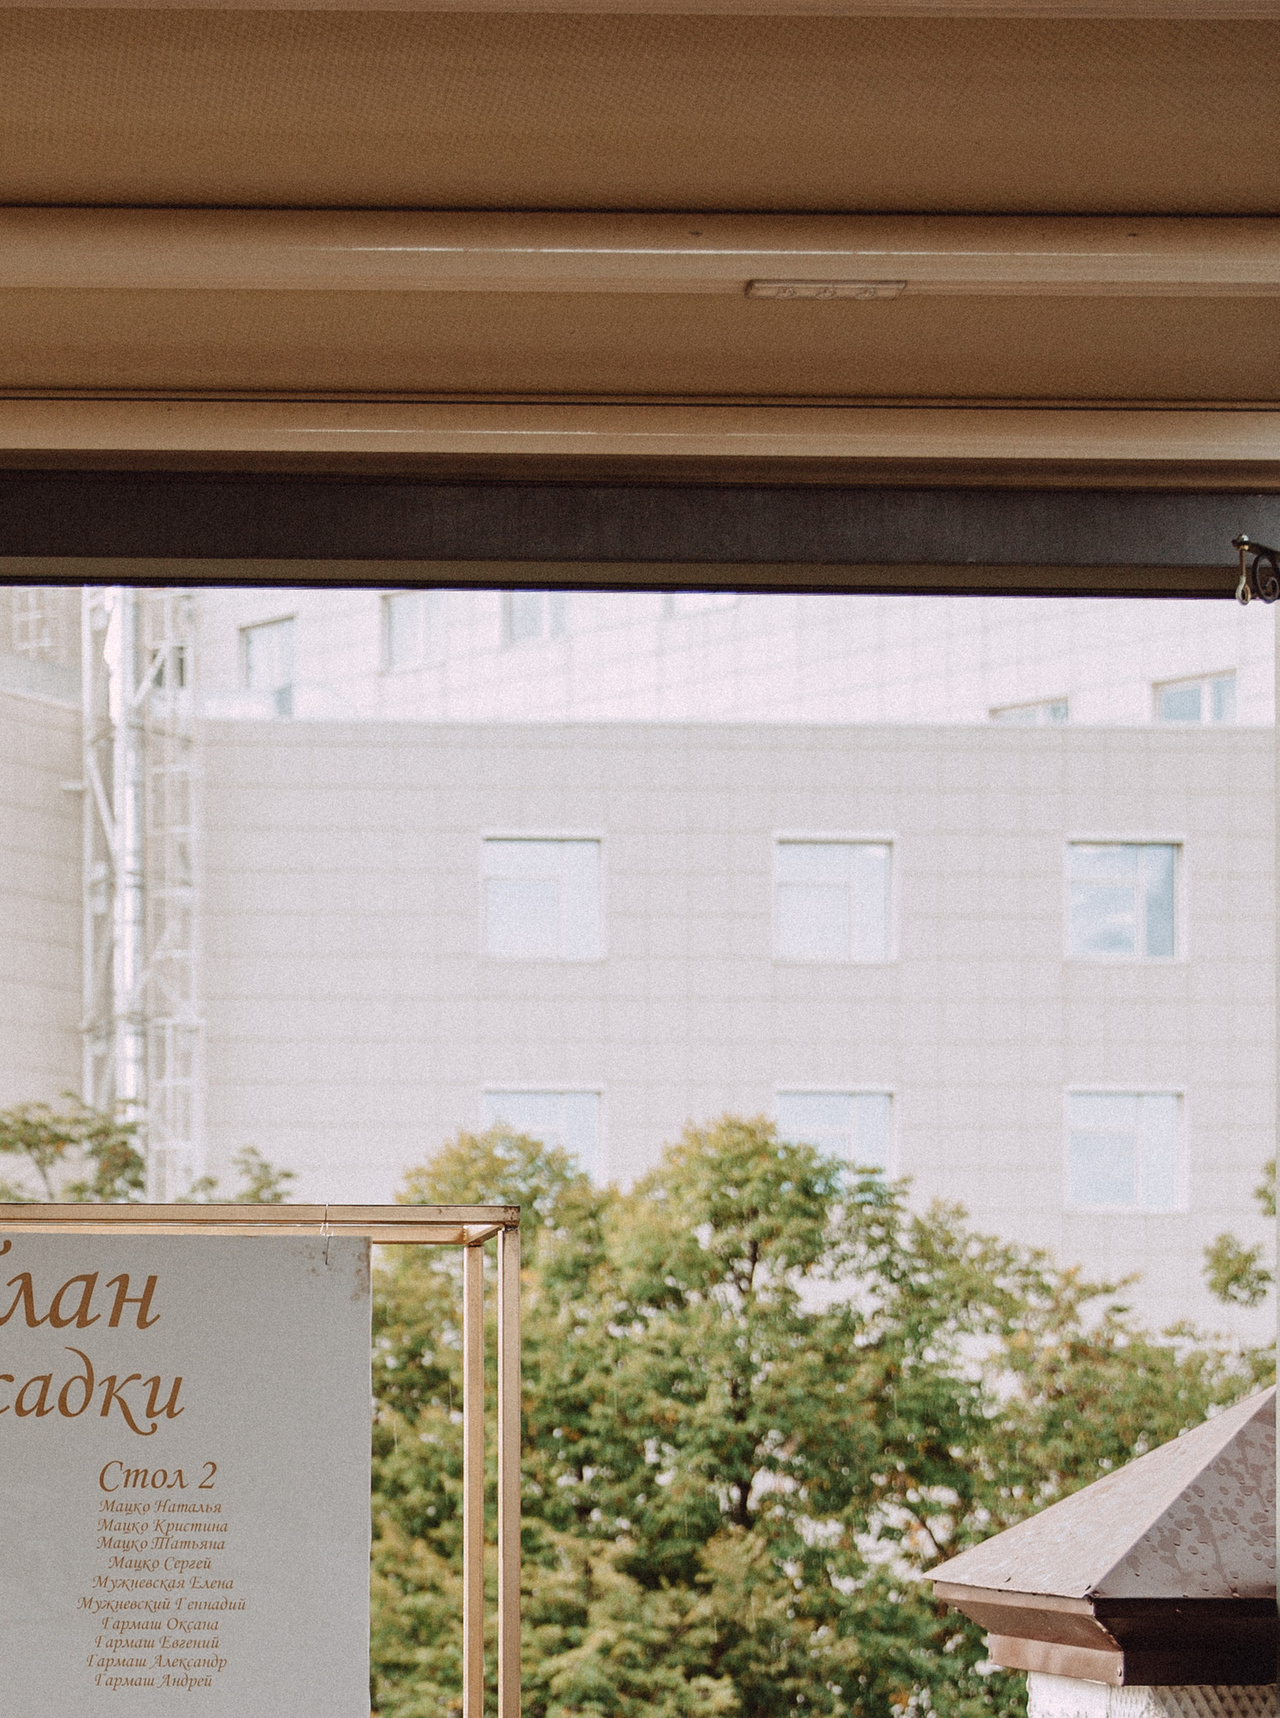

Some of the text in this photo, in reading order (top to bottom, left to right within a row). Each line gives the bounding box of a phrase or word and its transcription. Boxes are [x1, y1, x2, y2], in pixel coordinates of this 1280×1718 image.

[99, 1460, 217, 1492] Стол 2
[99, 1499, 221, 1514] Мацко Наталья
[97, 1519, 228, 1535] Мацко Кристина
[97, 1536, 225, 1551] Мацко Татьяна
[108, 1556, 211, 1573] Мацко Сергей
[92, 1575, 233, 1592] Мужневская Елена
[77, 1597, 245, 1614] Мужневский Геннадий
[102, 1617, 218, 1634] Гармаш Оксана
[95, 1636, 219, 1652] Гармаш Евгений
[86, 1655, 227, 1672] Гармаш Александр
[95, 1674, 212, 1691] Гармаш Андрей
